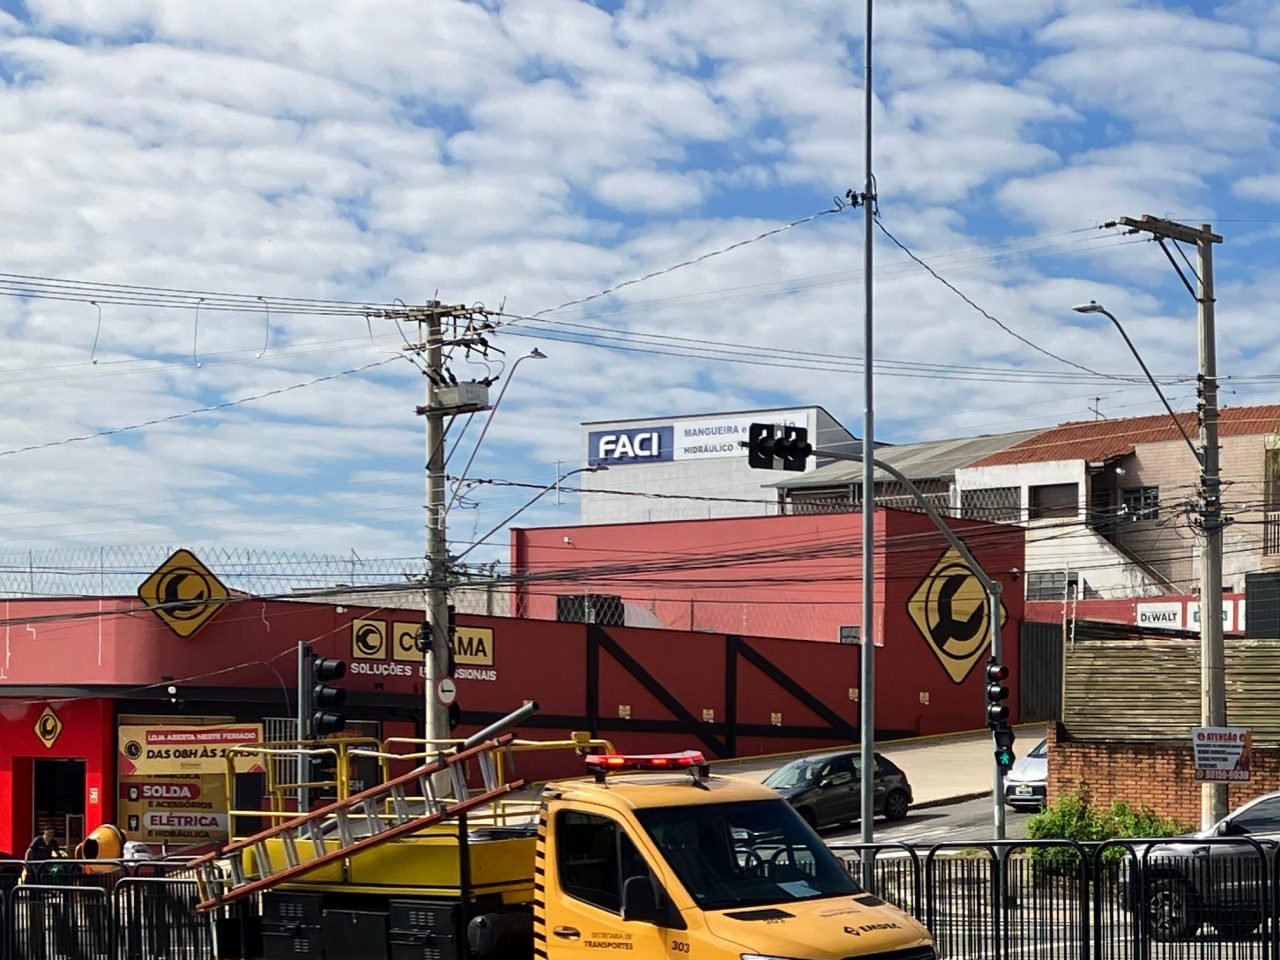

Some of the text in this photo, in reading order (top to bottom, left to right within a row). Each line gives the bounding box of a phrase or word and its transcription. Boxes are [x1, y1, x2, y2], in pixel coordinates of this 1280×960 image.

[684, 425, 739, 437] MANGUEIRA
[599, 432, 659, 459] FACI
[684, 443, 734, 454] HIDRÁULICO
[350, 662, 412, 676] SOLUÇÕES
[148, 734, 165, 742] LOJA
[222, 732, 256, 740] FERIADO
[146, 749, 171, 759] DAS
[173, 749, 198, 758] 08H
[200, 746, 217, 758] ÀS
[142, 785, 192, 798] SOLDA
[155, 800, 213, 809] ACESSÓRIOS
[150, 812, 219, 827] ELÉTRICA
[155, 830, 210, 838] HIDRÁULICA
[584, 940, 633, 950] TRANSPORTES
[672, 941, 690, 953] 303
